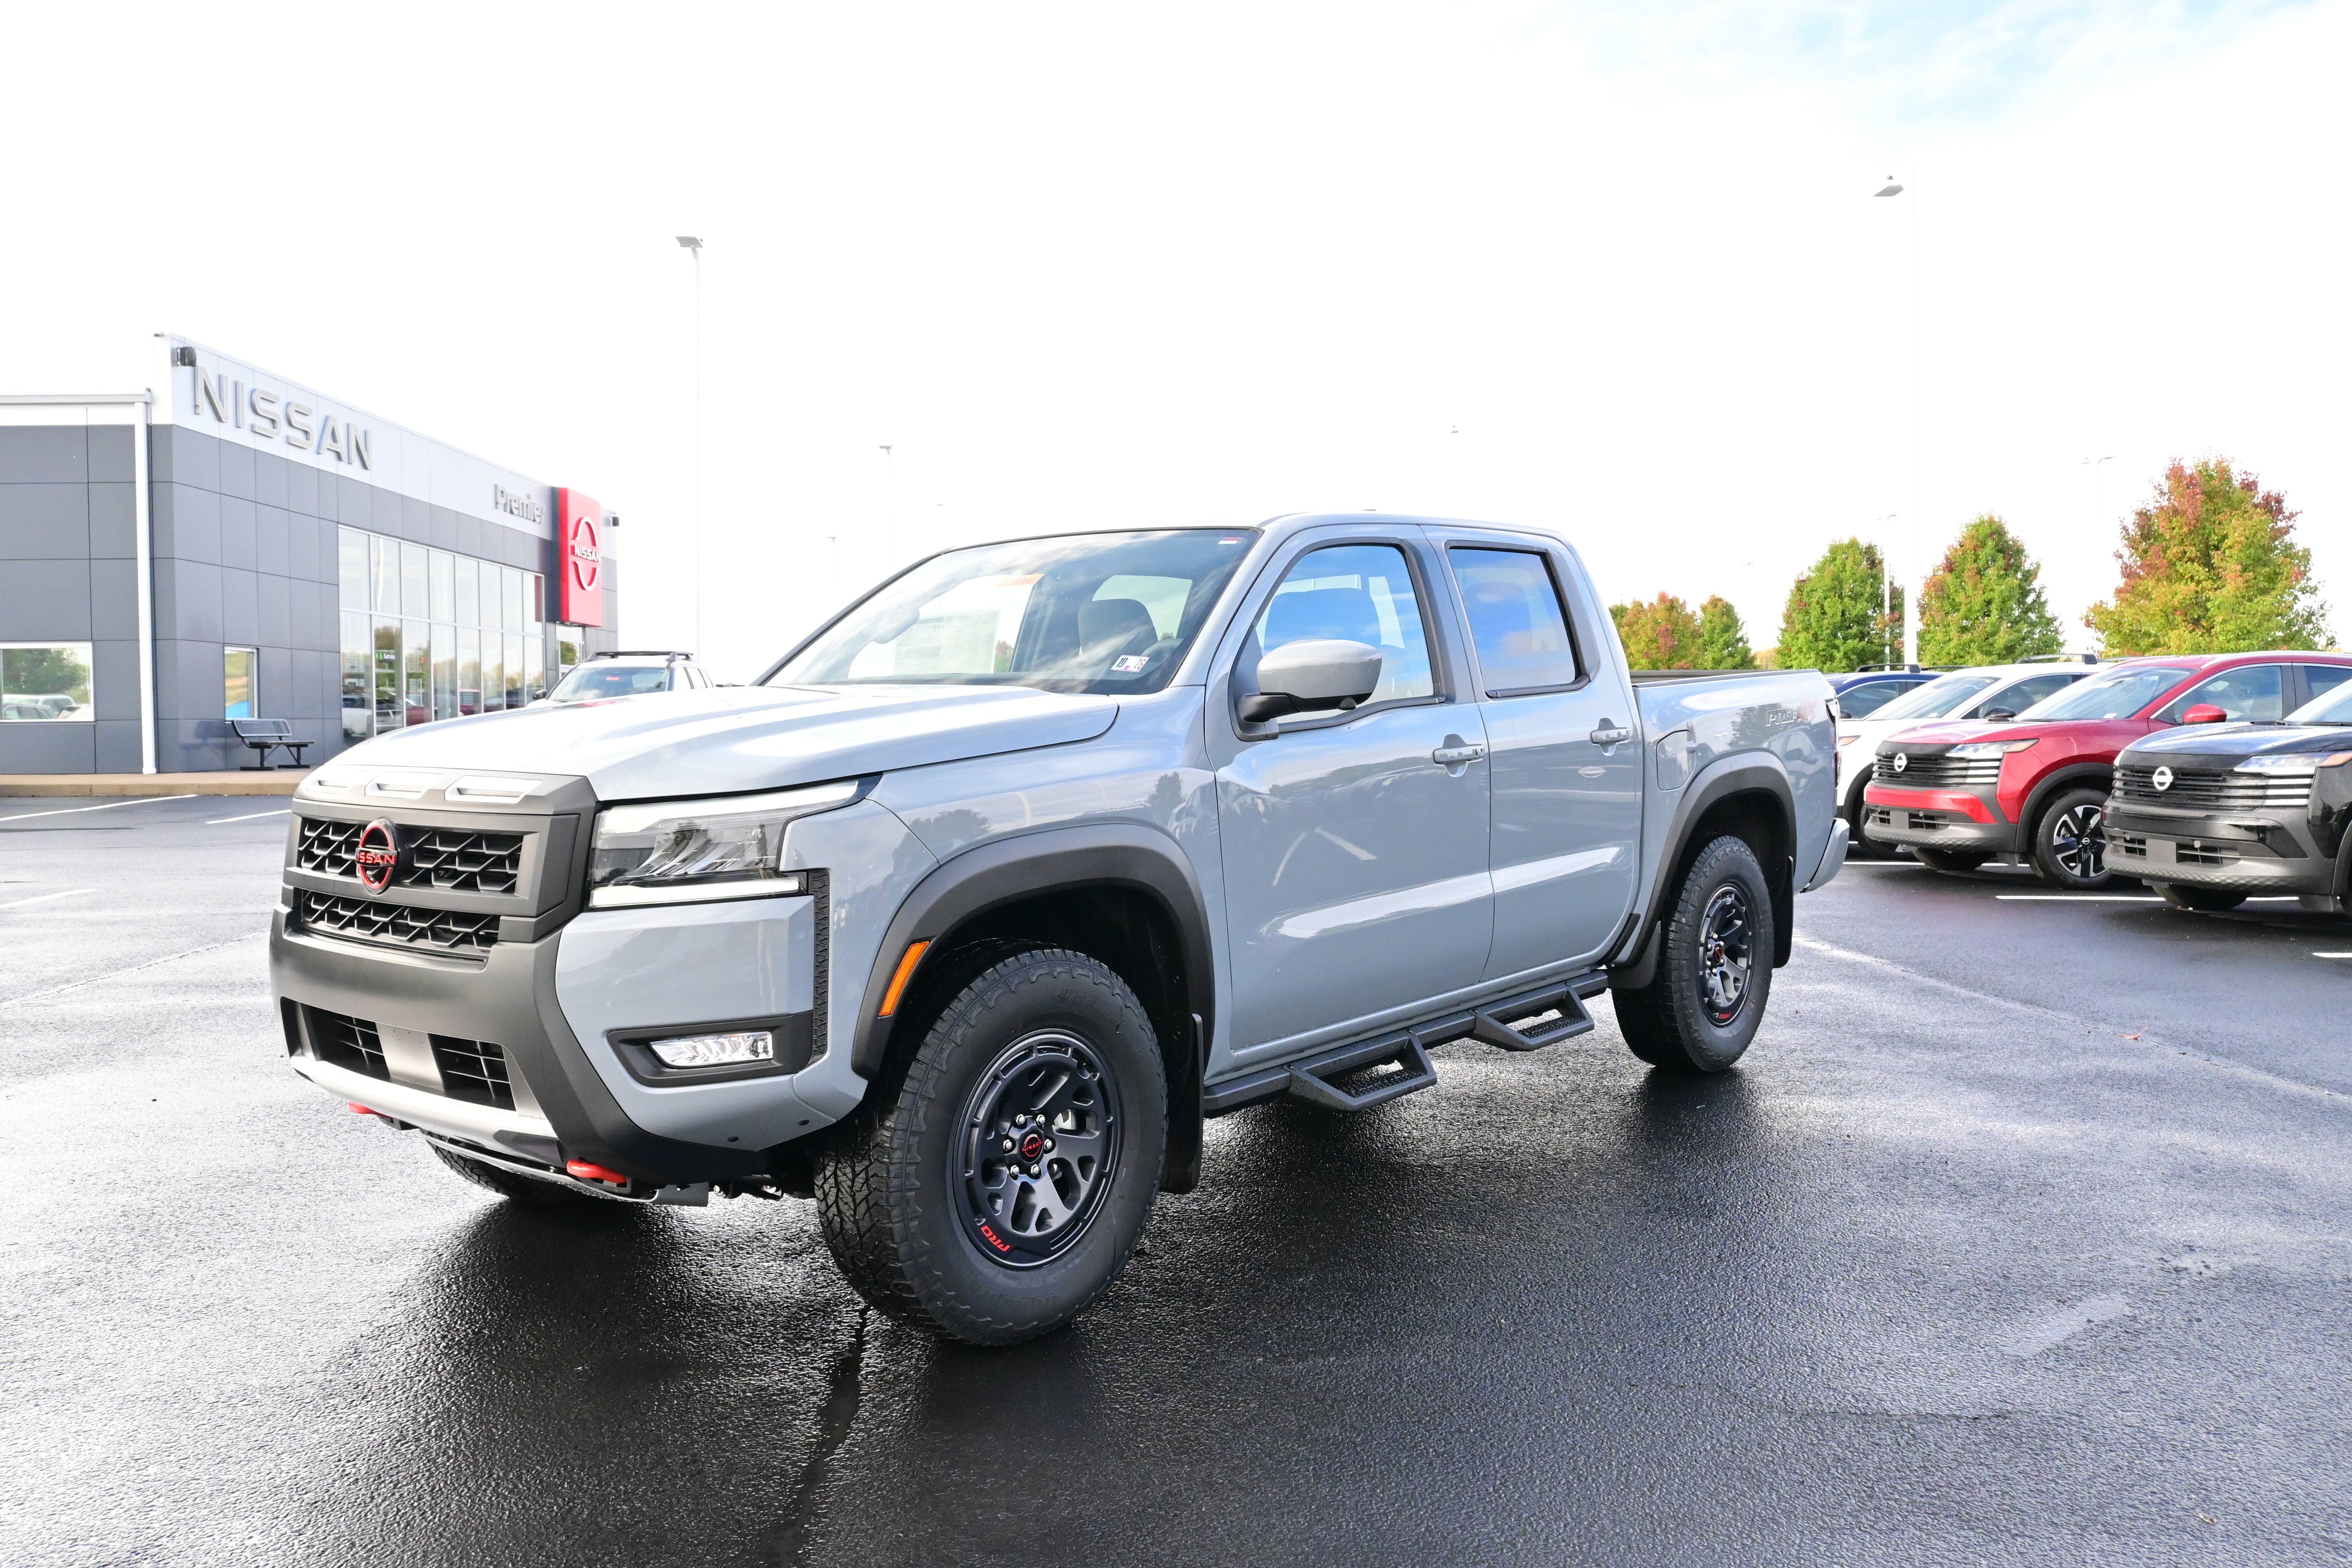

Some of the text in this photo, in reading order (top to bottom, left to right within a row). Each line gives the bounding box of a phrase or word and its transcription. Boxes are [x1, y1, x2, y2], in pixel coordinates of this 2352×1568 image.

[194, 365, 372, 470] NISSAN
[494, 484, 545, 523] Premier
[574, 544, 601, 562] NISSAN
[1134, 659, 1146, 669] 26
[1021, 1140, 1042, 1152] NISSAN
[980, 1225, 1011, 1252] PRO
